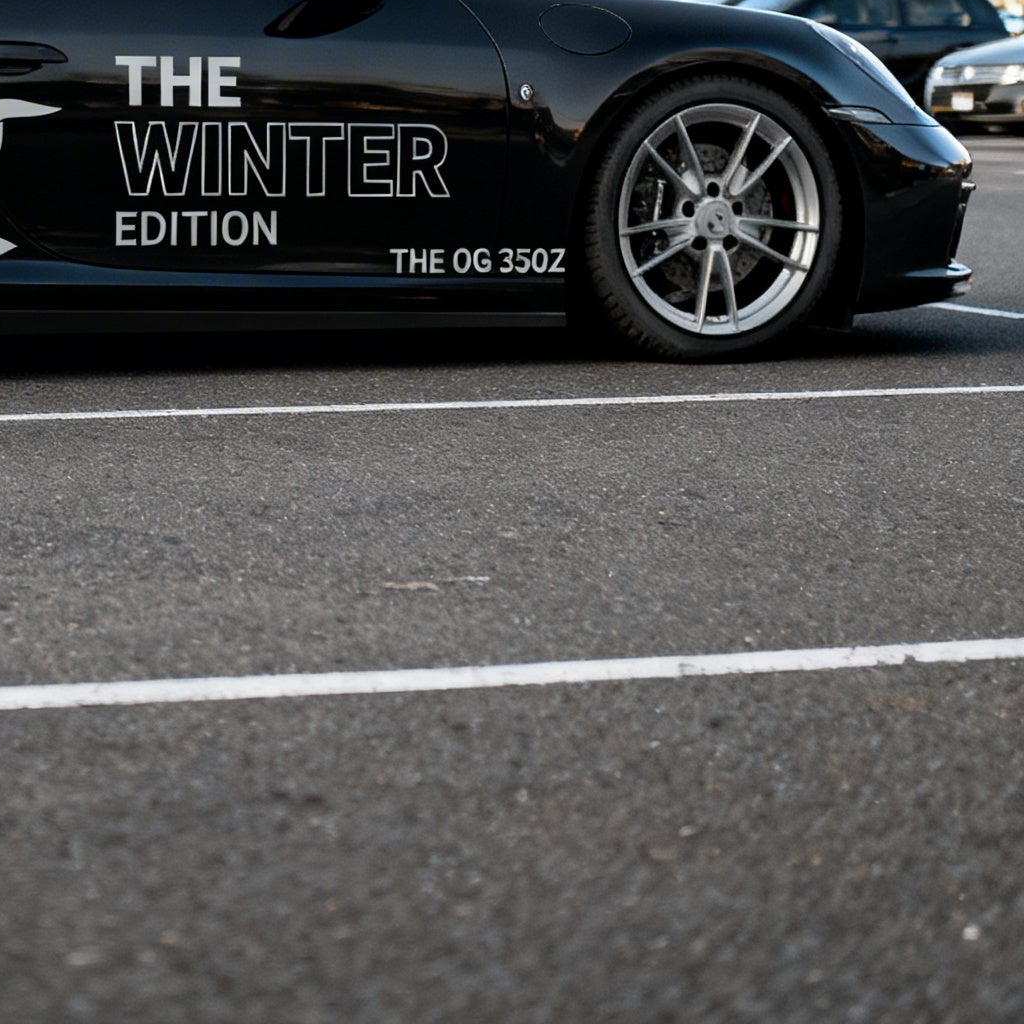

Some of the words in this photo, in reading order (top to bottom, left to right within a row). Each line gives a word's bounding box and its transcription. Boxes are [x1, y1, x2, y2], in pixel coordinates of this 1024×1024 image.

[115, 55, 241, 107] THE
[114, 121, 451, 198] WINTER
[115, 211, 278, 246] EDITION
[389, 249, 445, 274] THE
[453, 248, 492, 274] OG
[498, 248, 566, 273] 350Z
